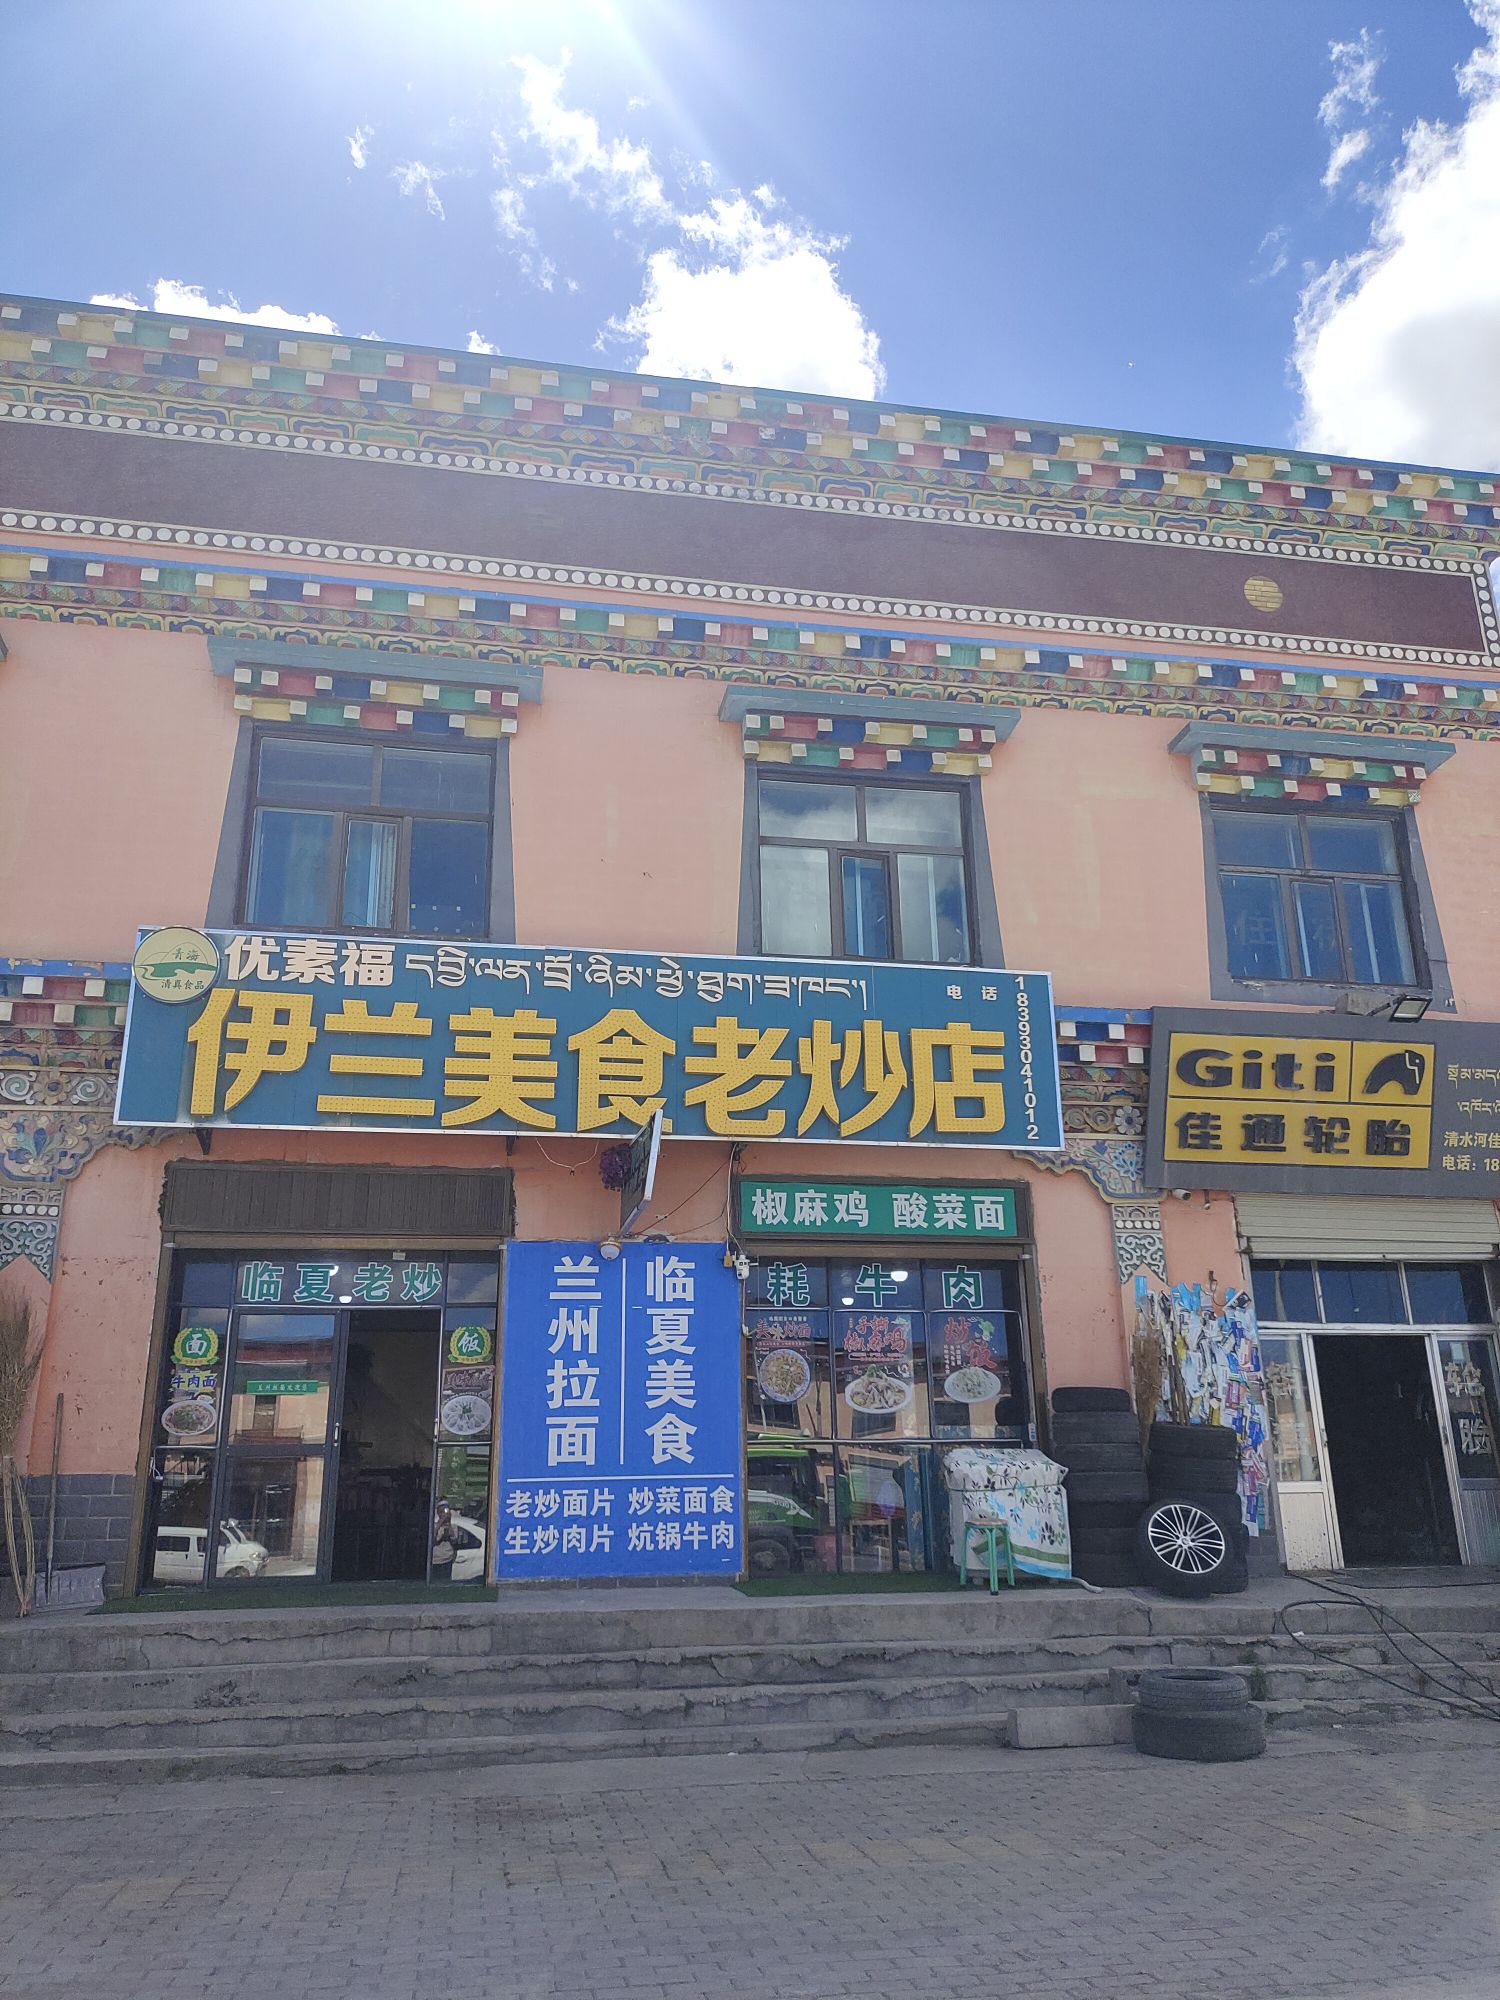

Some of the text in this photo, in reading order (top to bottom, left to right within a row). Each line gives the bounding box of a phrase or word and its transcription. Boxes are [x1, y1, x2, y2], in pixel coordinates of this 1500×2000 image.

[172, 948, 200, 961] 青海
[224, 936, 395, 986] 优素福
[161, 979, 204, 990] 清真食品
[946, 984, 998, 1002] 电话
[187, 988, 1007, 1138] 伊兰美食老炒店
[1014, 977, 1040, 1140] 18393041012
[1176, 1048, 1336, 1092] Giti
[1174, 1111, 1411, 1156] 佳通轮胎
[751, 1189, 1005, 1231] 椒麻鸡 酸菜面
[241, 1260, 443, 1303] 临夏老炒
[766, 1261, 984, 1309] 耗牛肉
[185, 1333, 208, 1356] 面
[458, 1331, 482, 1354] 饭
[756, 1318, 811, 1340] 美味炒面
[171, 1374, 217, 1389] 牛肉面
[546, 1255, 602, 1467] 兰州拉面
[644, 1255, 698, 1466] 临夏美食
[505, 1484, 736, 1519] 老炒面片 炒菜面食
[503, 1520, 735, 1556] 生炒肉片 炕锅牛肉
